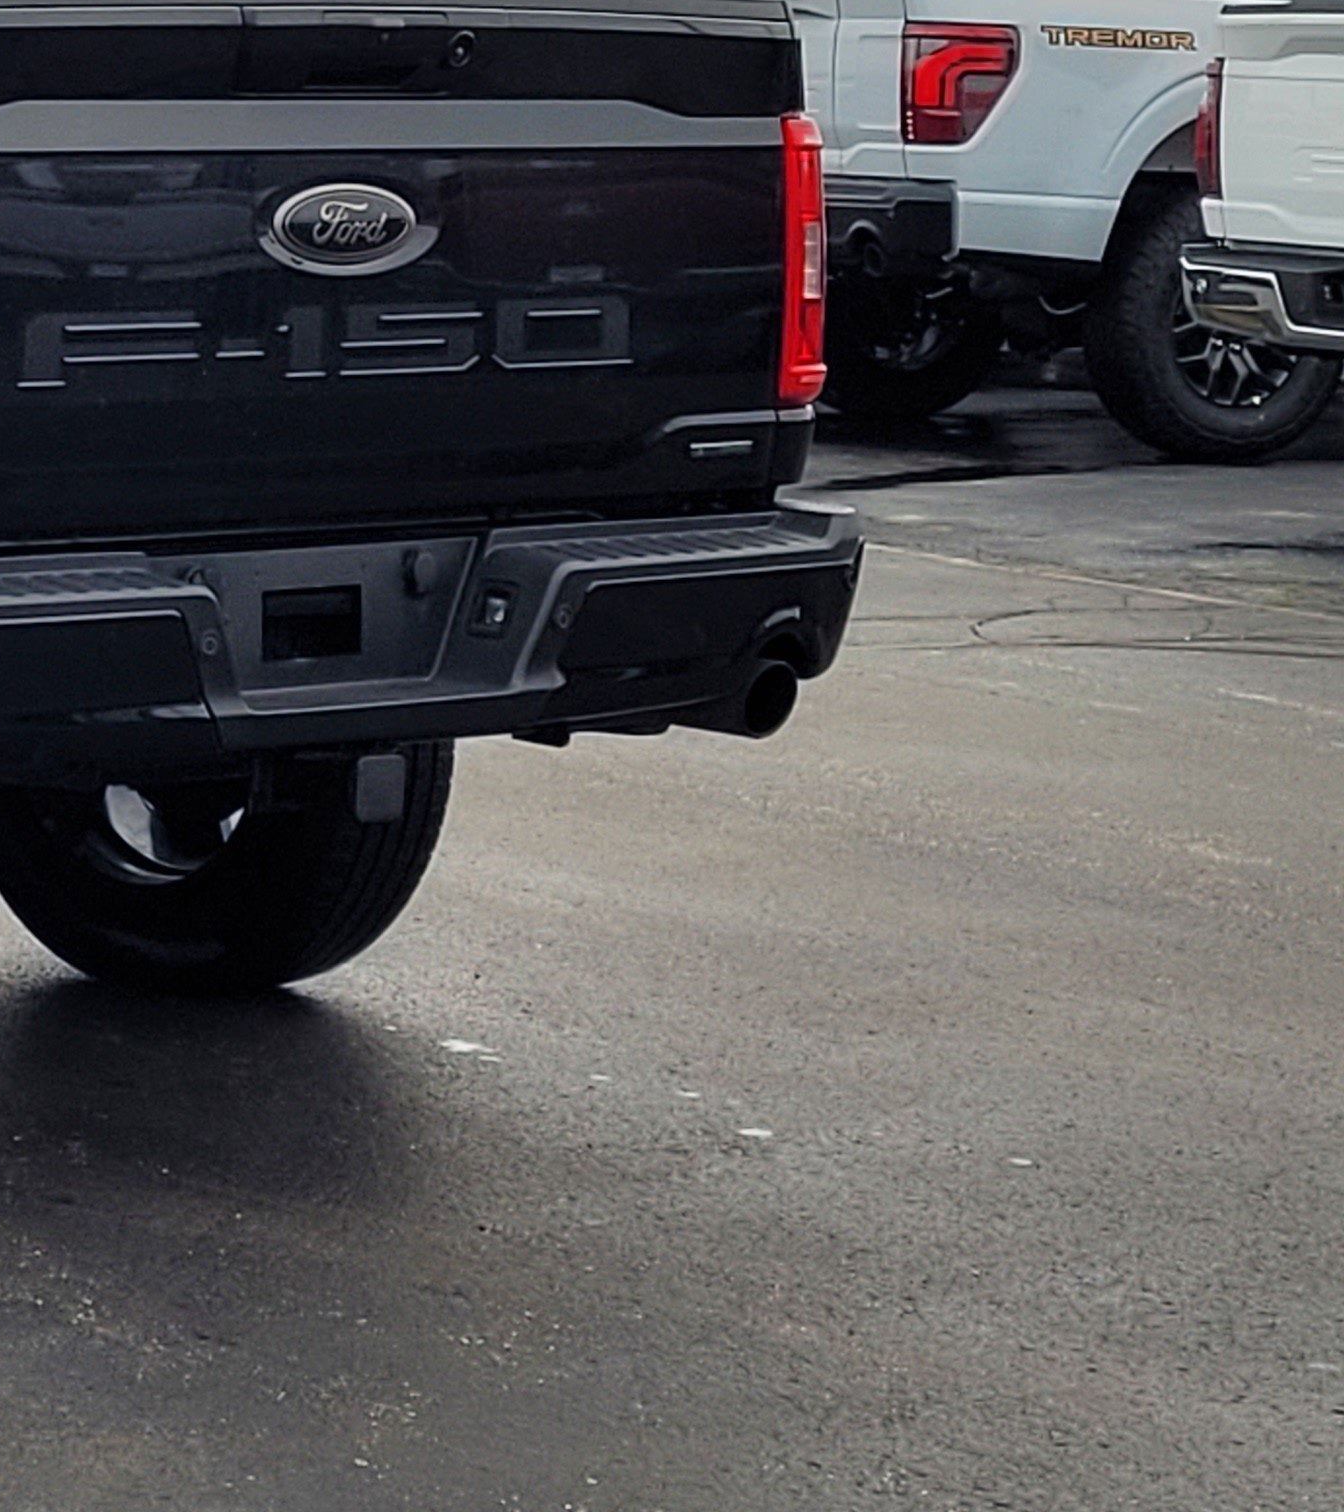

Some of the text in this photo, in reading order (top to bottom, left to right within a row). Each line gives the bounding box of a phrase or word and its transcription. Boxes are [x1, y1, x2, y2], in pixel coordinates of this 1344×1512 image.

[1040, 24, 1197, 51] TREMOR
[312, 200, 388, 246] Ford
[16, 294, 635, 388] F-150
